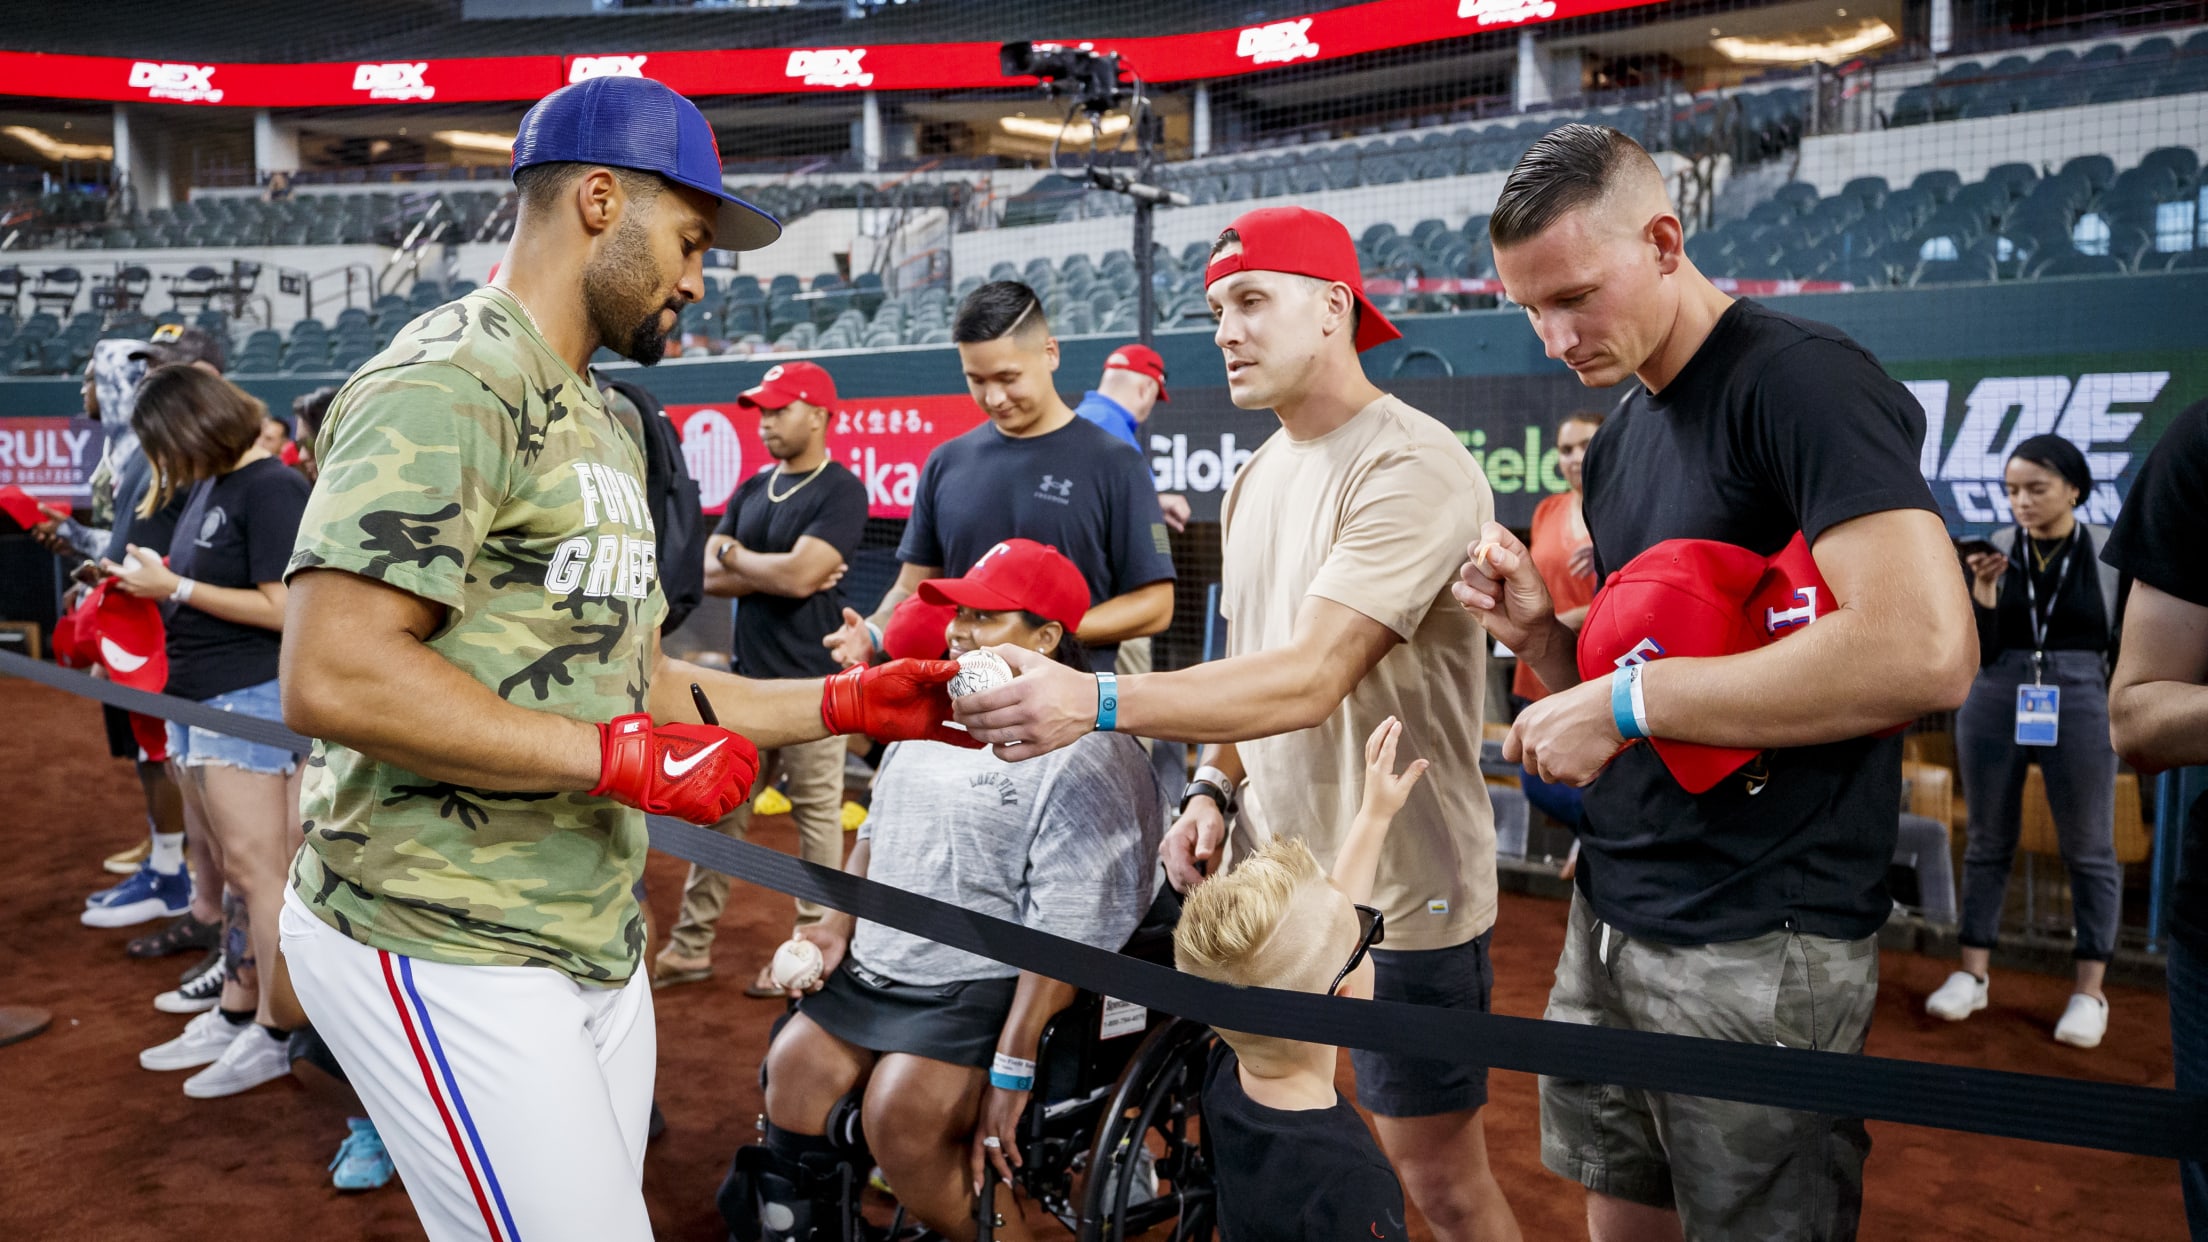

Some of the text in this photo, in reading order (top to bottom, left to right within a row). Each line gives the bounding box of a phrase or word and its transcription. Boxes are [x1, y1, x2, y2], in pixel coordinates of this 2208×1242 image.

[1236, 19, 1312, 57] DEX
[129, 62, 215, 91] DEX
[353, 62, 428, 90] DEX
[569, 55, 648, 83] DEX
[786, 48, 867, 77] DEX
[835, 409, 934, 435] よく生きる。
[968, 771, 1018, 806] LOVE PINK
